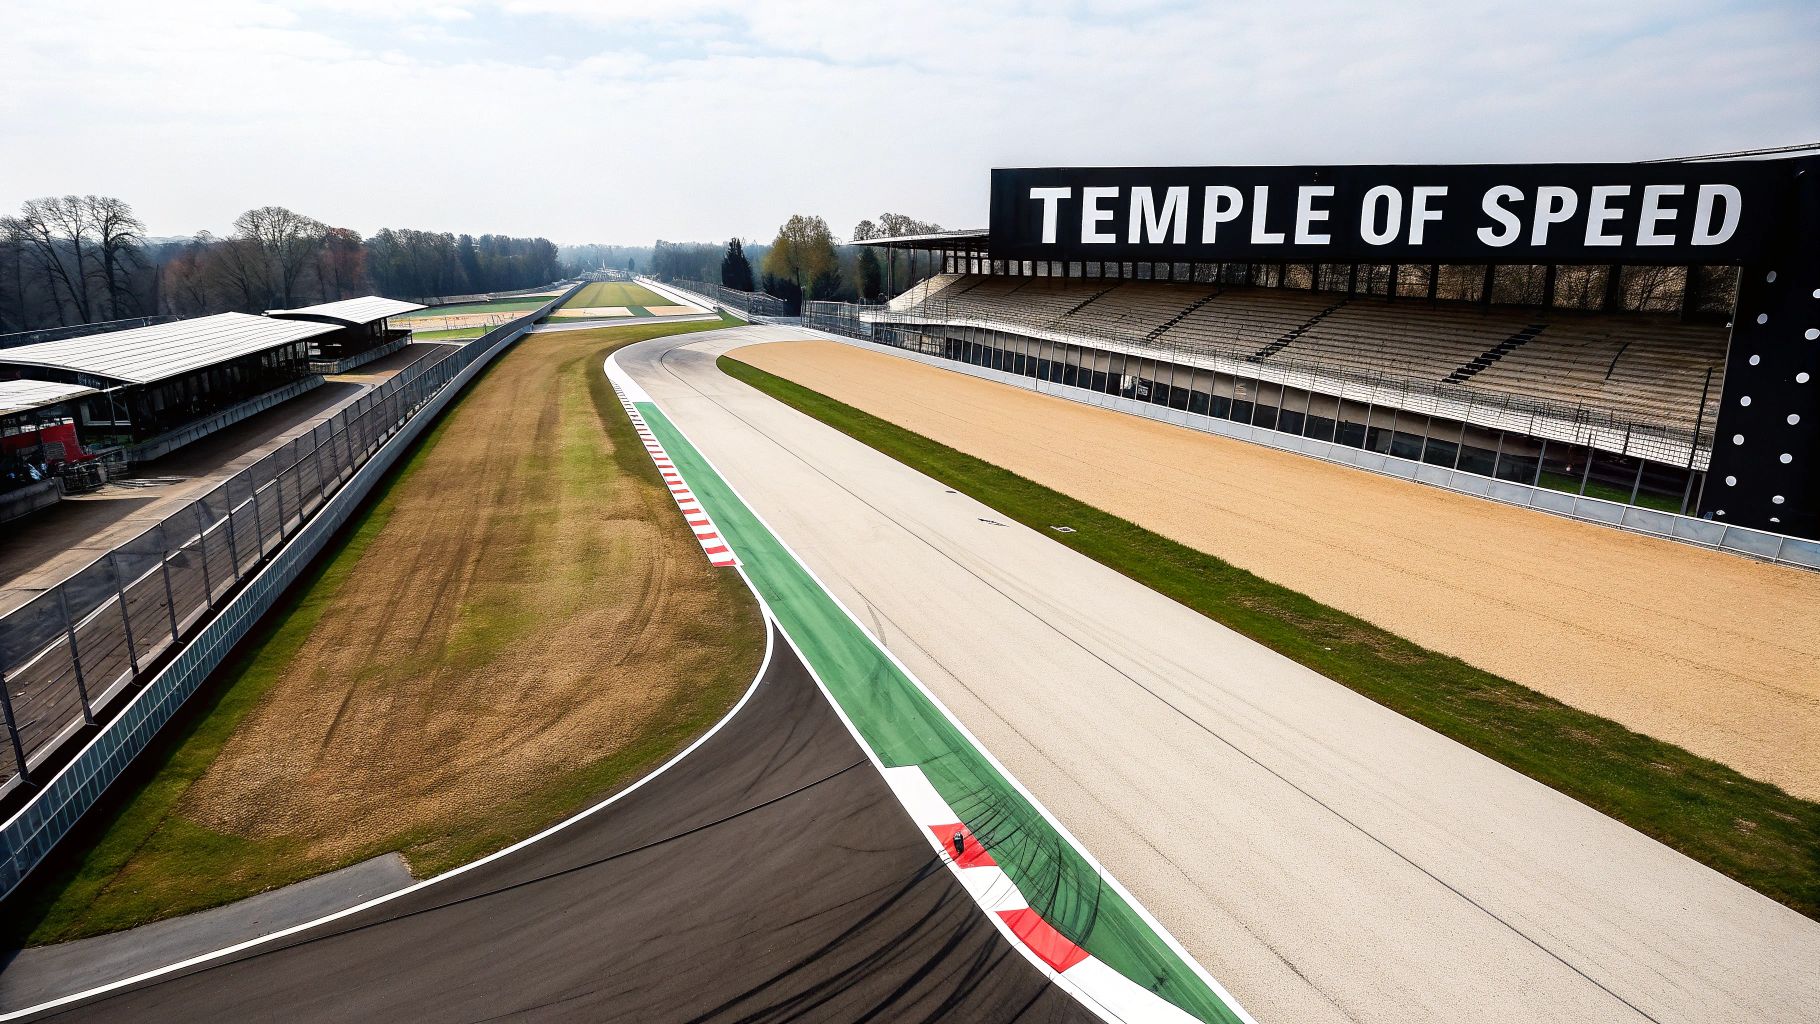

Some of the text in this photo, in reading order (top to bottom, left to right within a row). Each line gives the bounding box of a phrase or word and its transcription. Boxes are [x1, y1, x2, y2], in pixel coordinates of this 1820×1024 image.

[1030, 184, 1742, 246] TEMPLE OF SPEED
